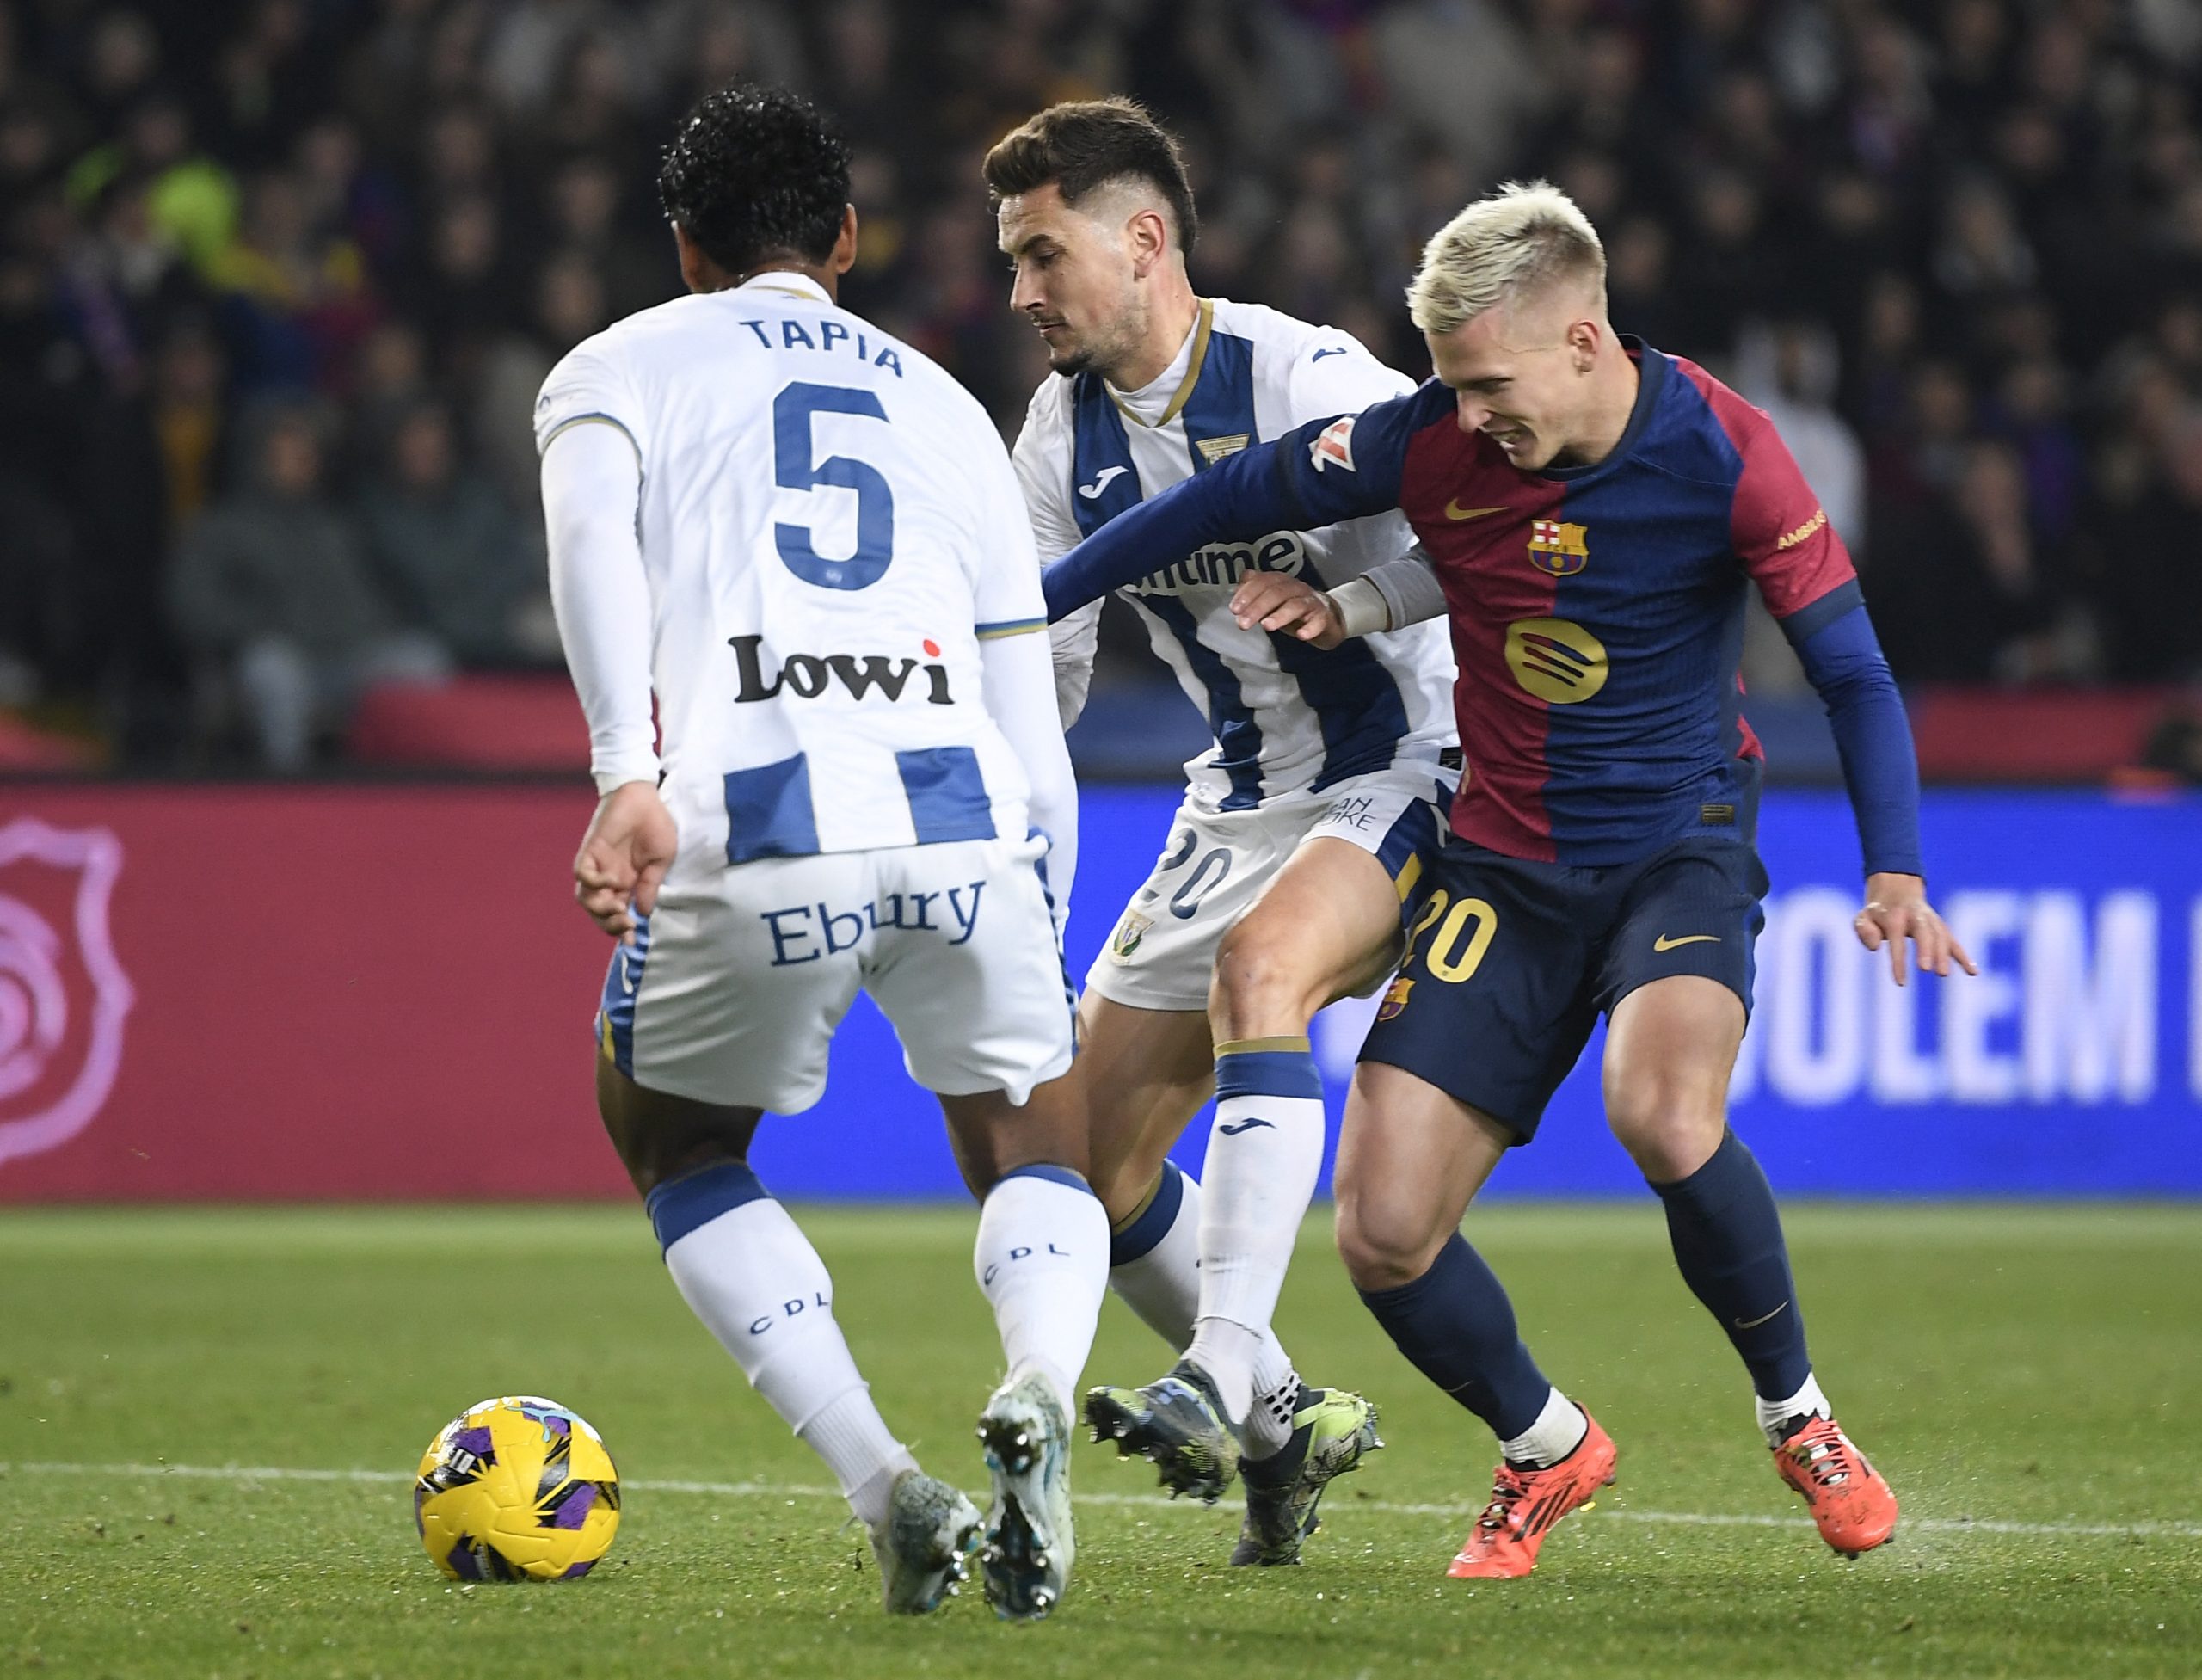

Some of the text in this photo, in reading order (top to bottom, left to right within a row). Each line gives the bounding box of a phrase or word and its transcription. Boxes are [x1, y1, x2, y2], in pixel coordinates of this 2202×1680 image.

[740, 319, 904, 378] TAPIA
[773, 382, 895, 591] 5
[1135, 538, 1295, 589] ntime
[728, 635, 955, 705] Lowi
[1330, 797, 1373, 814] AN
[761, 880, 987, 967] Ebury
[1402, 889, 1498, 983] 20
